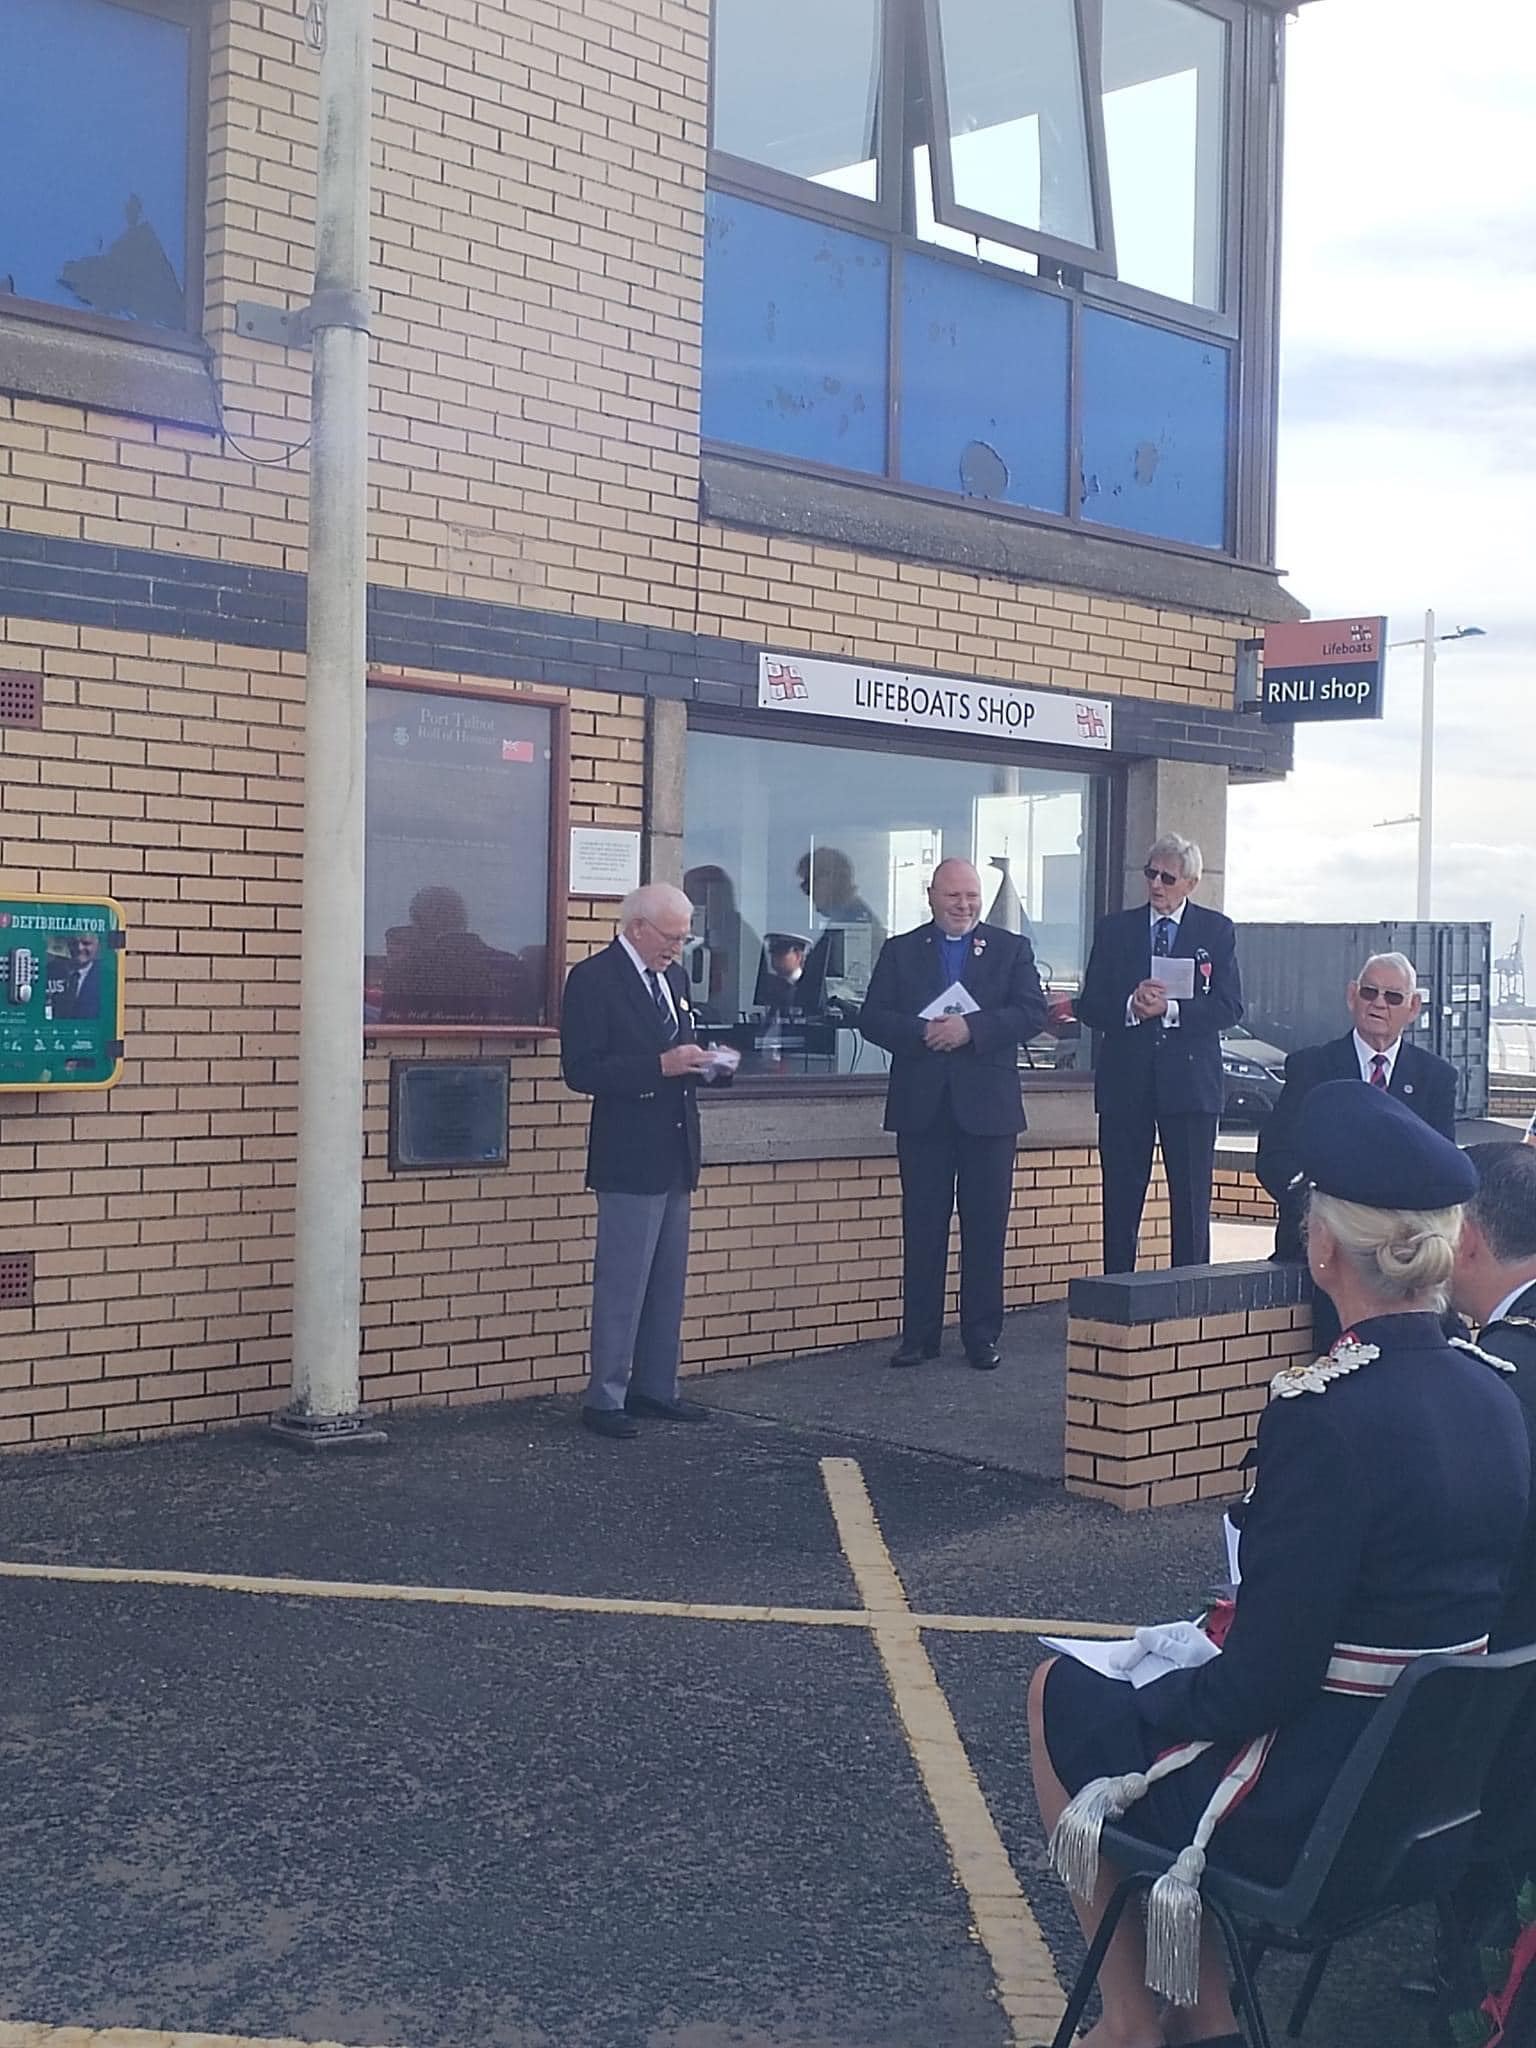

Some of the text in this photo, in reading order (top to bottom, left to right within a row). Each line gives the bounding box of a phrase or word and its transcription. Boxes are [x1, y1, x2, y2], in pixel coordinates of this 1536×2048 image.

[1322, 642, 1373, 656] Lifeboats
[1268, 677, 1370, 704] RNLI shop
[855, 677, 1036, 728] LIFEBOATS SHOP
[420, 708, 449, 726] Port
[11, 915, 105, 932] DEFIBRILLATOR
